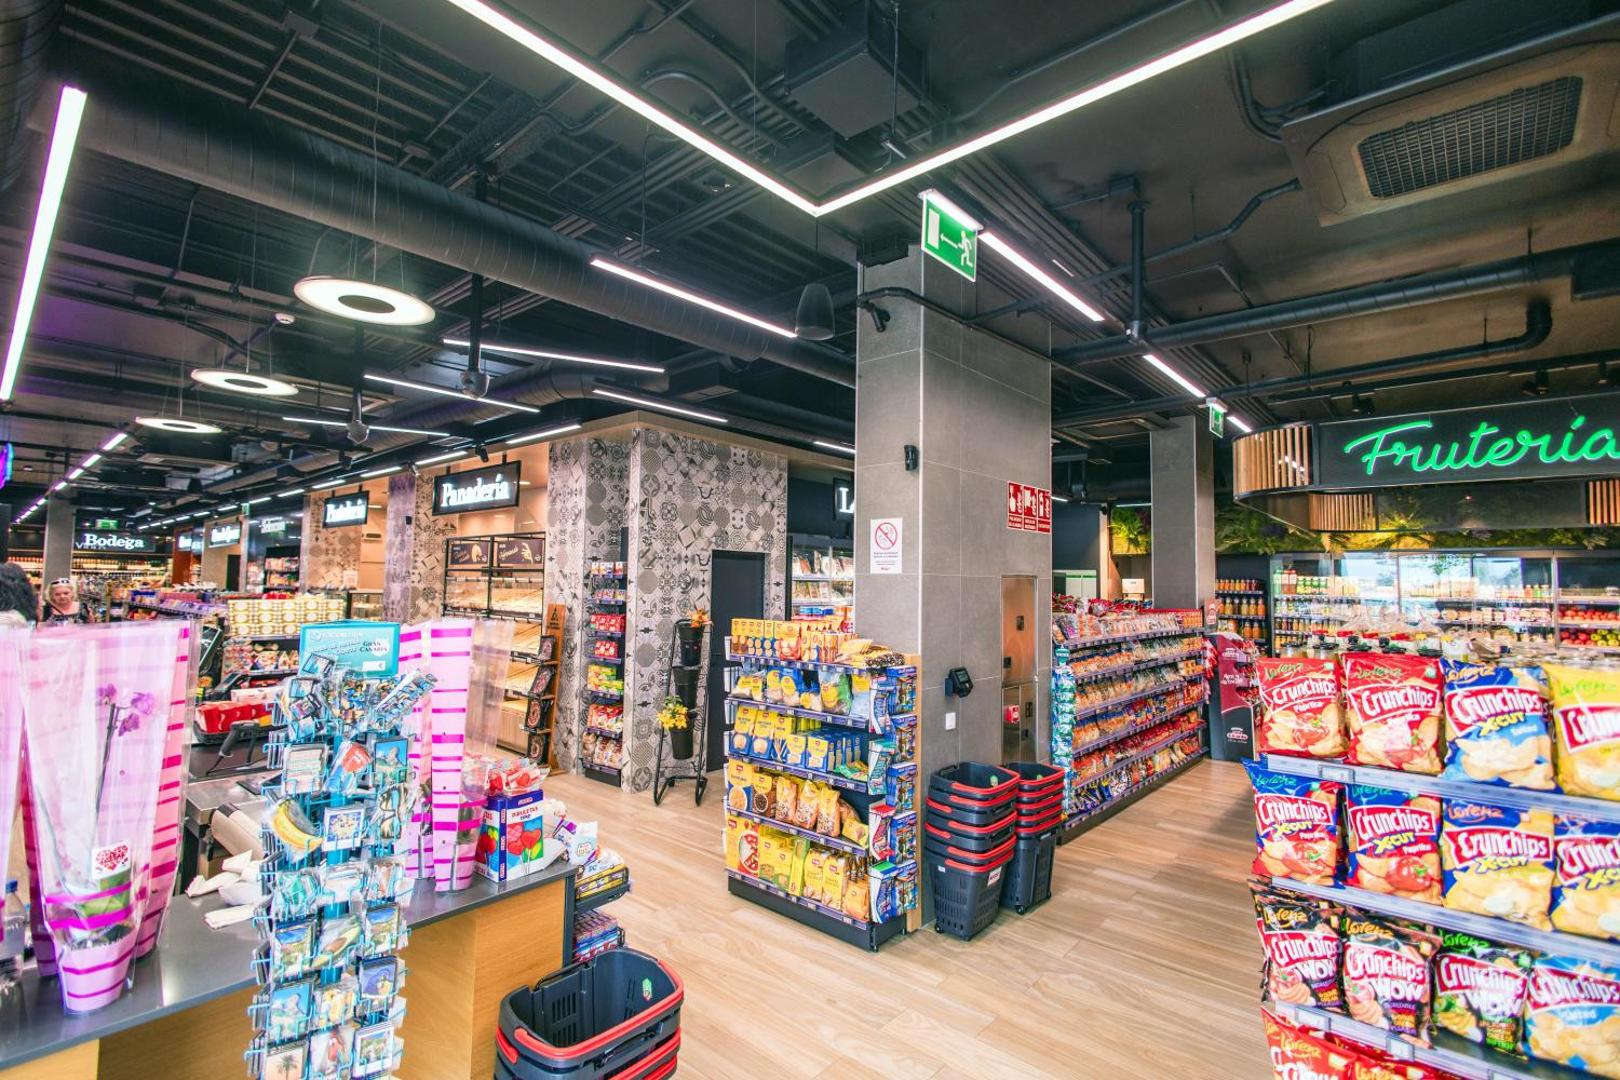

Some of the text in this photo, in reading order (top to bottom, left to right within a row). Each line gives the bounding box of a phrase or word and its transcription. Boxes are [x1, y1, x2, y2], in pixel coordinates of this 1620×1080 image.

[1344, 415, 1620, 475] Frutería
[440, 474, 510, 507] Panadería
[84, 533, 144, 550] Bodega
[1271, 677, 1336, 705] Crunchips
[1362, 686, 1434, 717] Crunchips
[1451, 688, 1541, 725] Crunchips
[1258, 798, 1328, 826] Crunchips
[1356, 808, 1431, 841] Crunchips
[1457, 831, 1548, 859] Crunchips
[1271, 934, 1338, 966] Crunchips
[1345, 946, 1425, 981] Crunchips
[1373, 977, 1424, 1002] WOW
[1440, 957, 1524, 994] Crunchips
[1530, 974, 1620, 1003] Crunchips
